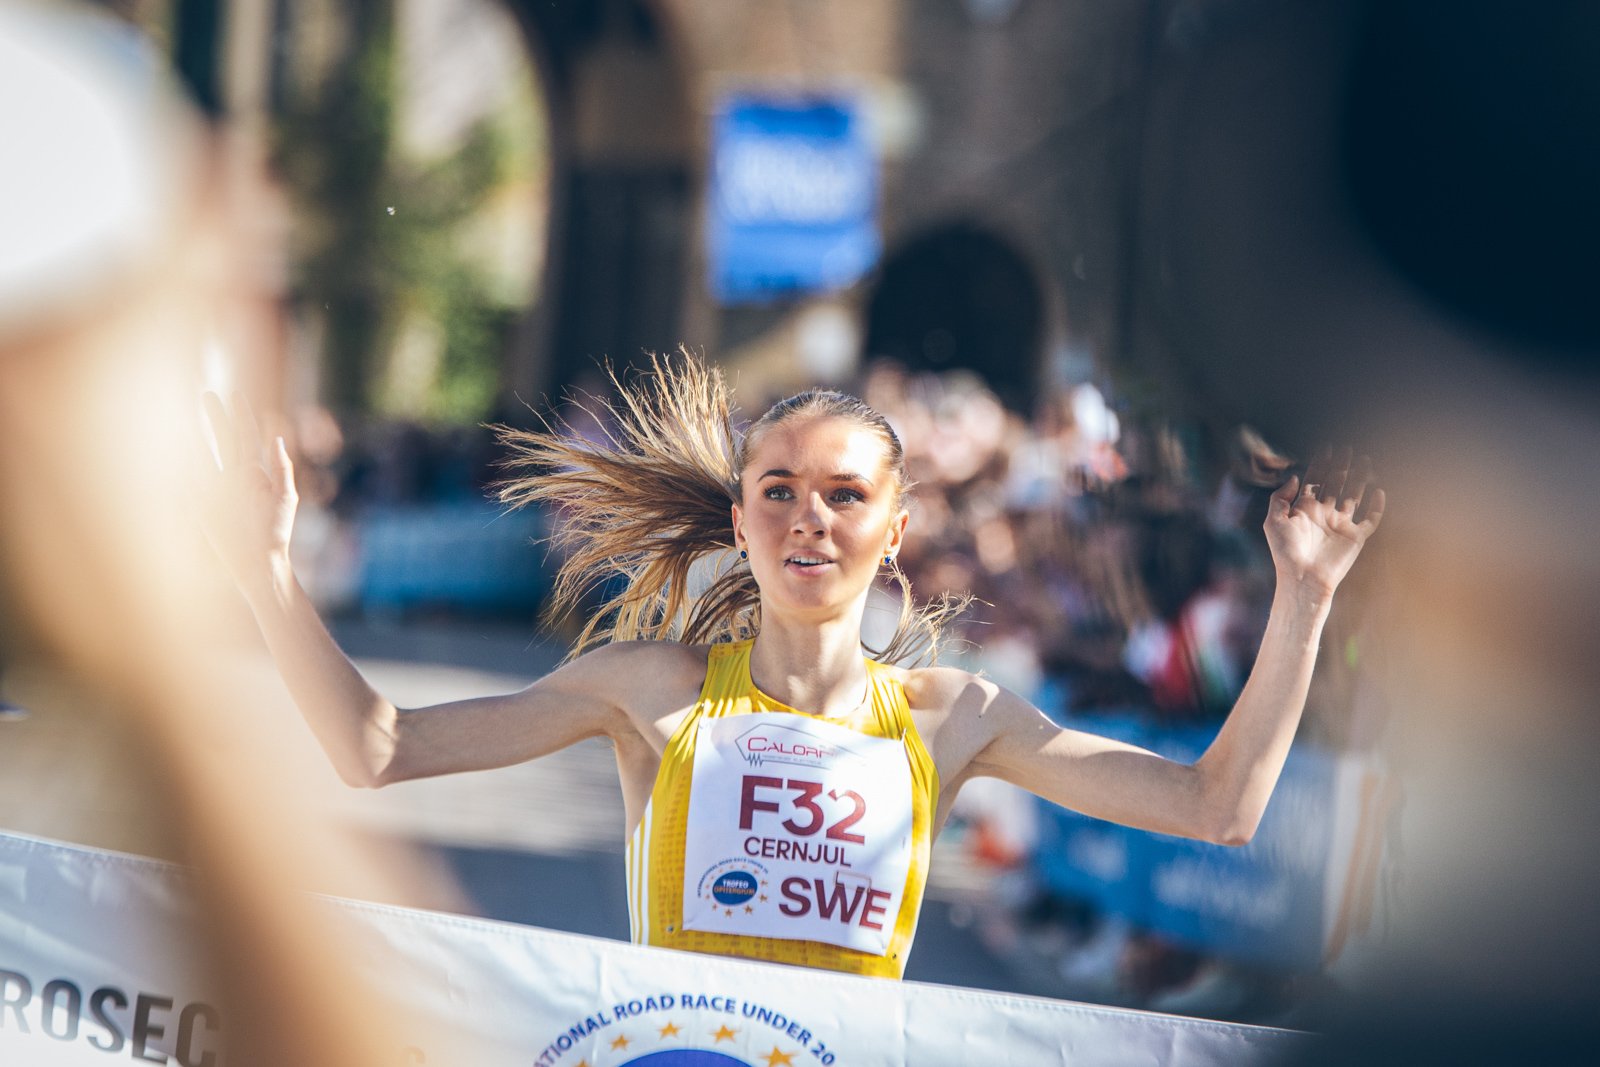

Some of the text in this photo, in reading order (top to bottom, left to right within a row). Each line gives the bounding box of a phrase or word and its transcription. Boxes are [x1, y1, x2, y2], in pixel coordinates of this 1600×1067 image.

[738, 774, 867, 846] F32
[743, 836, 852, 868] CERNJUL
[778, 876, 892, 931] SWE
[0, 968, 221, 1067] ROSEC
[613, 994, 676, 1022] ROAD
[680, 994, 737, 1014] RACE
[740, 1001, 813, 1048] UNDER
[809, 1041, 837, 1067] 20
